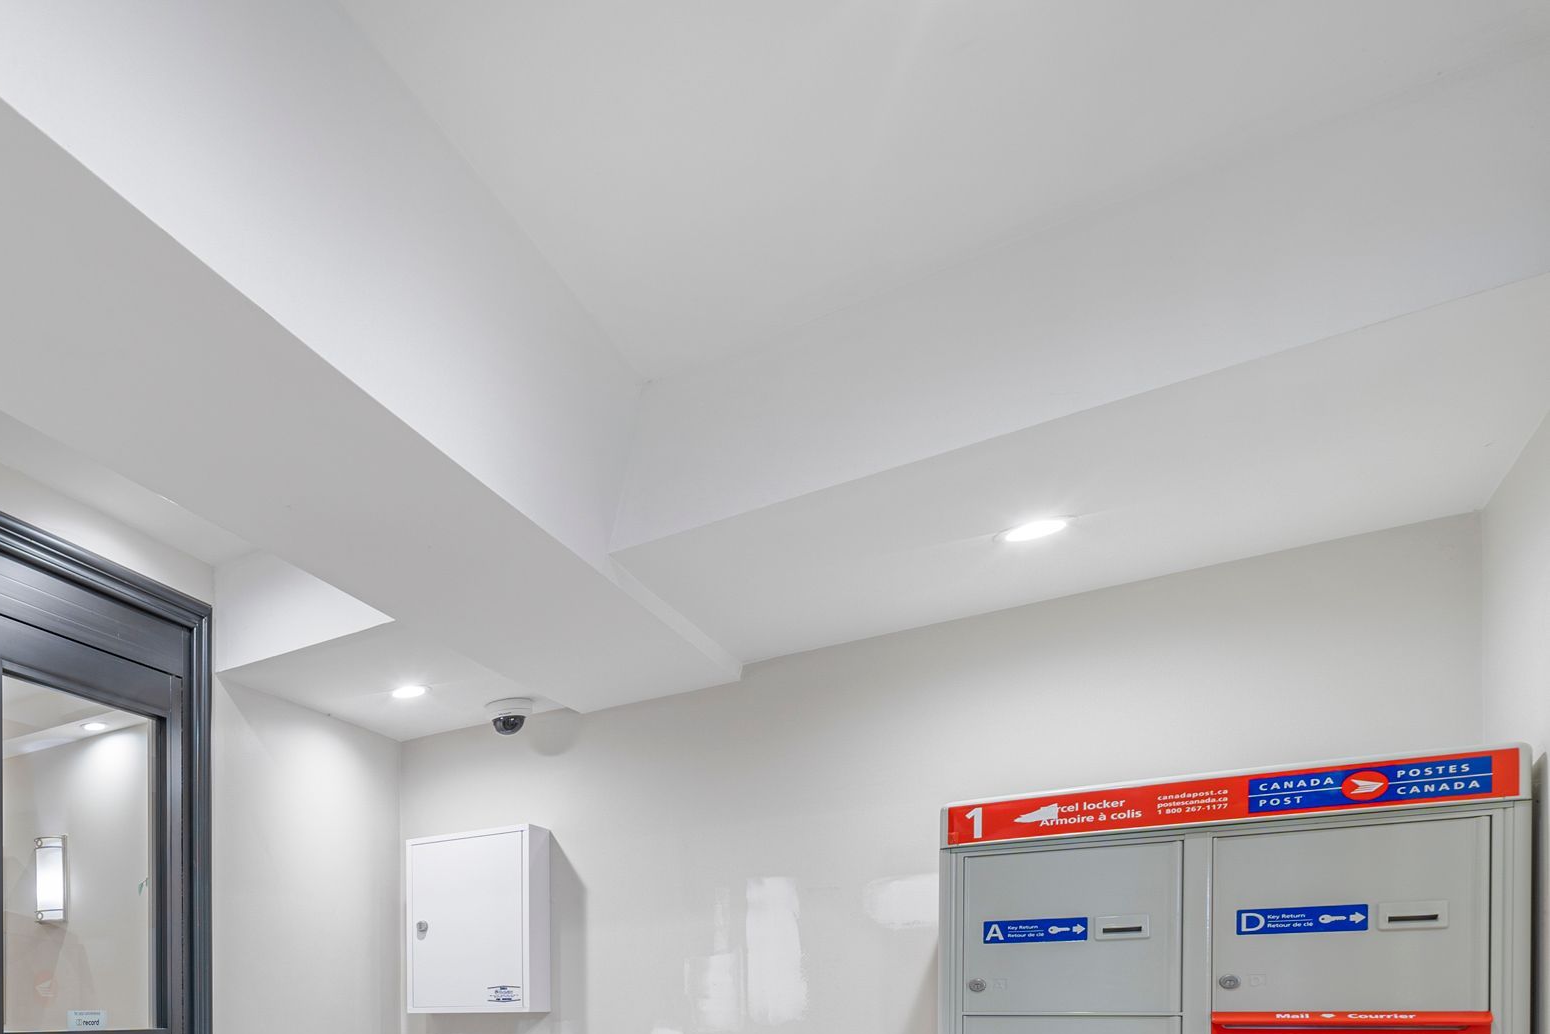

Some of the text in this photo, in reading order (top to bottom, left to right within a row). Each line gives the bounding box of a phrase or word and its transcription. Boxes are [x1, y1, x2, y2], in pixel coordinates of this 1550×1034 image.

[1396, 763, 1470, 778] POSTES
[1258, 777, 1334, 791] CANADA
[1396, 780, 1481, 795] CANADA
[1157, 789, 1228, 800] canadapost.ca
[1258, 796, 1303, 807] POST
[1083, 799, 1126, 810] locker
[1157, 797, 1228, 809] postescanada.ca
[1185, 803, 1228, 812] 267-1177
[965, 807, 983, 839] 1
[1039, 809, 1142, 827] Armoire à colis
[1241, 912, 1265, 932] D
[986, 924, 1004, 940] A
